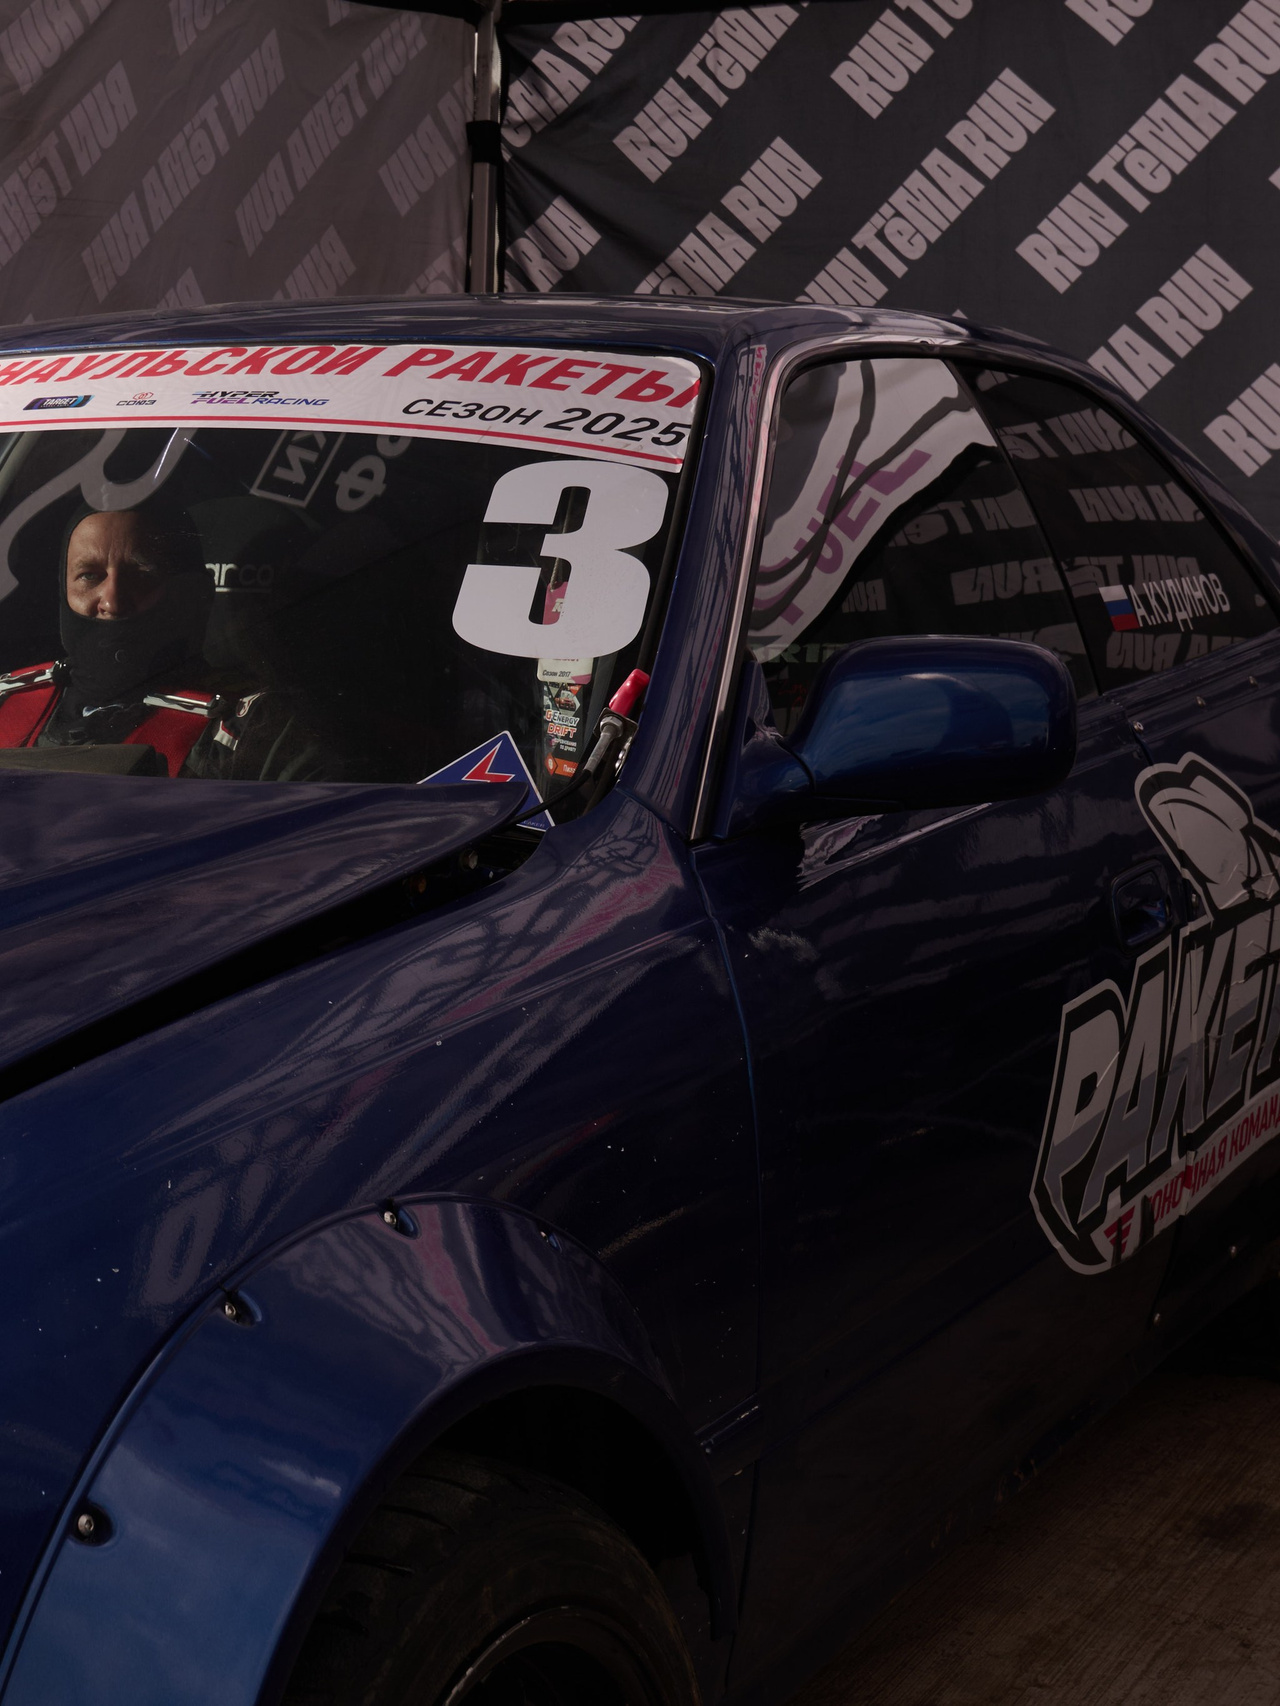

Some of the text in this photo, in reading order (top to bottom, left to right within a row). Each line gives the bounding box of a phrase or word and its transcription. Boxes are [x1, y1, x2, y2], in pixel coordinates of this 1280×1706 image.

[830, 8, 935, 120] RUN
[613, 76, 713, 184] RUN
[945, 67, 1056, 180] RUN
[720, 136, 823, 243] RUN
[1015, 182, 1129, 294] RUN
[1135, 243, 1253, 359] RUN
[252, 398, 330, 406] RACING
[381, 347, 701, 409] РАКЕТЫ
[402, 398, 693, 446] СЕЗОН 2025
[452, 460, 669, 658] 3
[1128, 573, 1231, 632] А.КУДИНОВ
[547, 723, 577, 738] DRIFT
[1229, 1094, 1280, 1162] КОМАН
